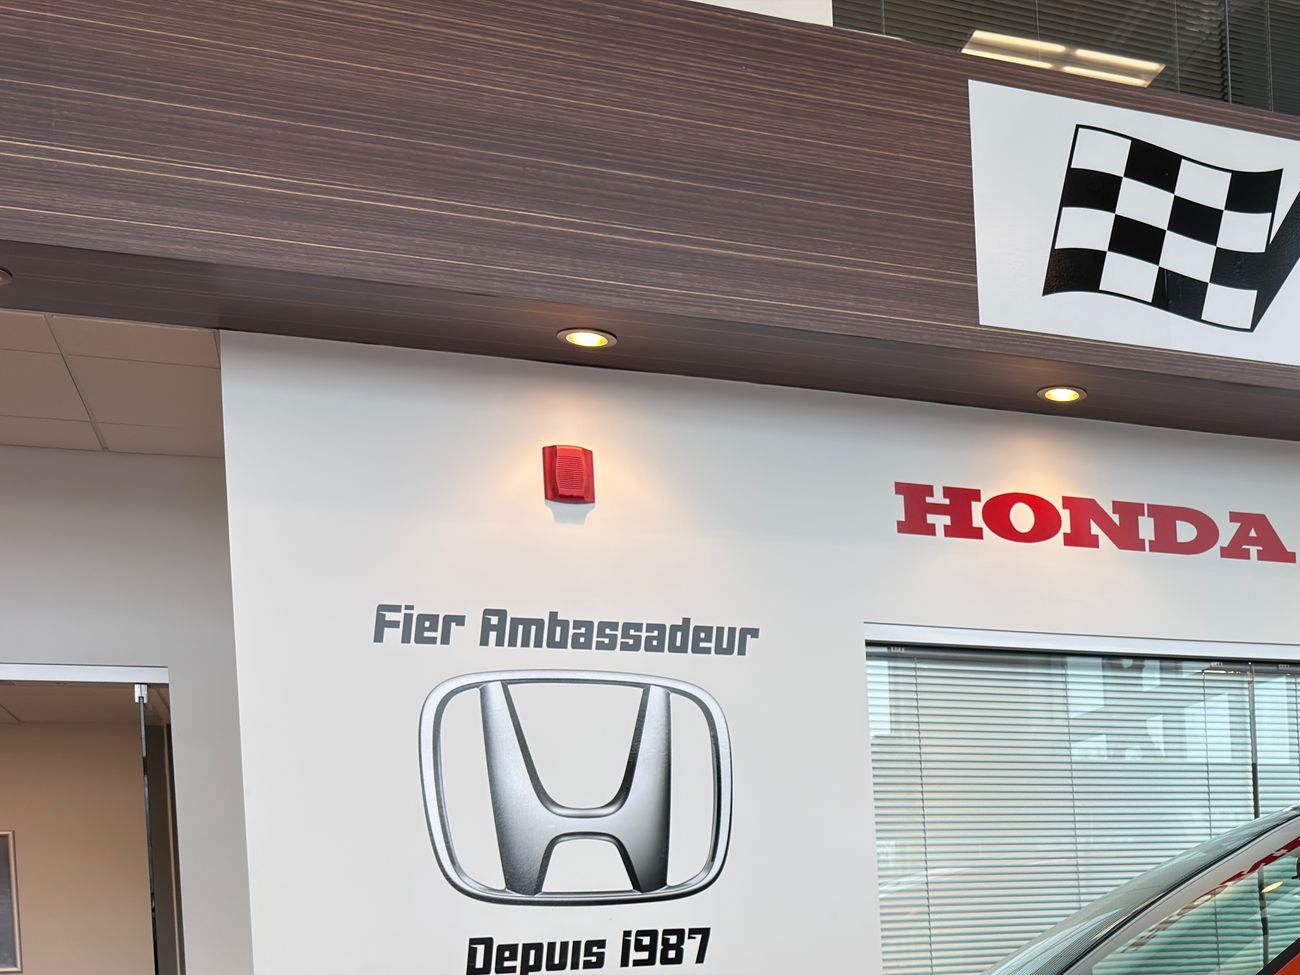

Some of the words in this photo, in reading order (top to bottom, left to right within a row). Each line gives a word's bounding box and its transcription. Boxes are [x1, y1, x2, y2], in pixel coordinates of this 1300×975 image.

[895, 482, 1297, 564] HONDA
[373, 604, 467, 645] Fier
[479, 608, 760, 656] Ambassadeur
[620, 927, 712, 968] 1987
